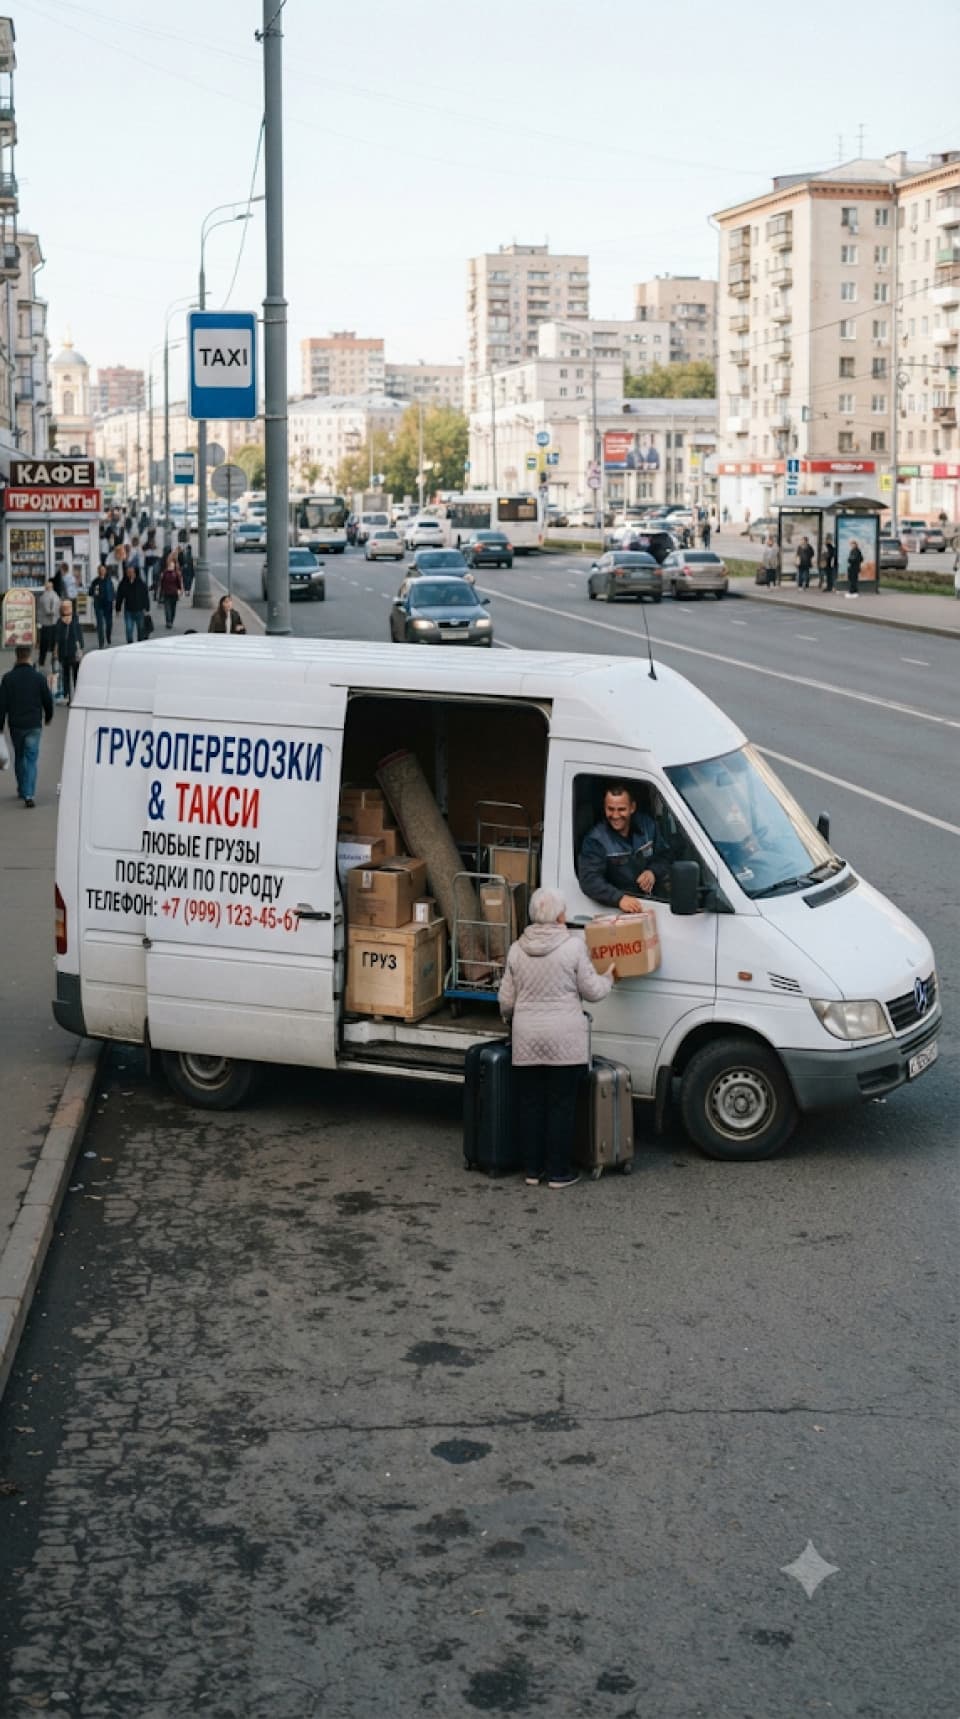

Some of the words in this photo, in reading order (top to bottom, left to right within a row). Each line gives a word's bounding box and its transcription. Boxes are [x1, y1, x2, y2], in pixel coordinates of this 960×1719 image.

[199, 348, 248, 367] TAXI
[17, 464, 90, 484] КАФЕ
[9, 493, 97, 511] ПРОДУКТЫ
[96, 726, 323, 782] ГРУЗОПЕРЕВОЗКИ
[148, 780, 164, 820] &
[176, 782, 260, 828] ТАКСИ
[141, 831, 201, 858] ЛЮБЫЕ
[205, 837, 260, 864] ГРУЗЫ
[115, 860, 188, 890] ПОЕЗДКИ
[193, 867, 215, 892] ПО
[220, 870, 283, 902] ГОРОДУ
[86, 888, 157, 917] ТЕЛЕФОН:
[161, 898, 180, 919] +7
[183, 899, 221, 928] (999)
[226, 904, 301, 932] 123-45-67
[362, 951, 397, 970] ГРУЗ
